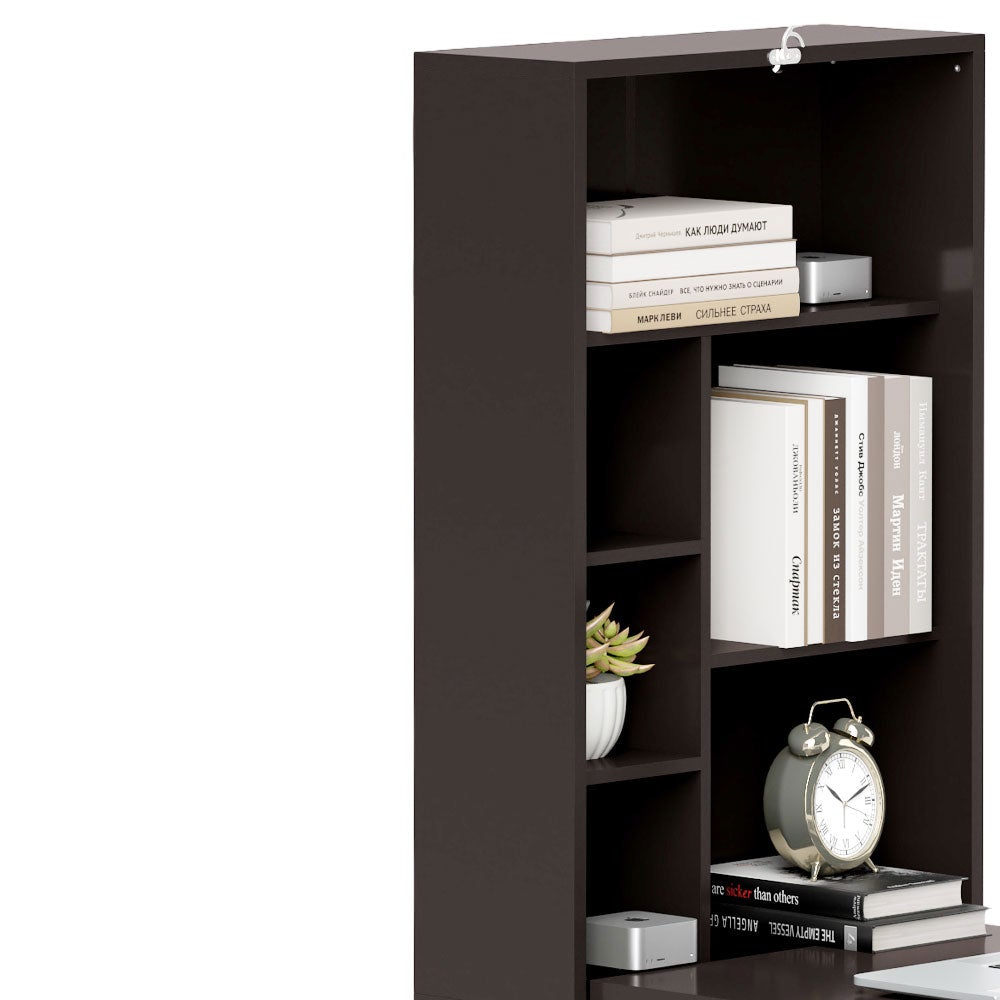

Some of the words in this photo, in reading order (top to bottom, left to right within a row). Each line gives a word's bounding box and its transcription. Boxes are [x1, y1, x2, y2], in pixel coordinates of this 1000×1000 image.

[685, 225, 702, 238] КАК
[703, 223, 729, 236] ЛЮДИ
[730, 220, 768, 235] ДУМАЮТ
[629, 290, 647, 299] БЛЕЙК
[648, 288, 674, 298] СНАЙДЕР
[693, 286, 704, 294] ЧТО
[705, 284, 728, 293] НУЖНО
[728, 282, 746, 291] ЗНАТЬ
[637, 313, 659, 324] МАРК
[659, 312, 682, 322] ЛЕВИ
[695, 306, 737, 320] СИЛЬНЕЕ
[740, 303, 772, 317] СТРАХА
[792, 444, 800, 514] ДЖОВАНЬОЛИ
[857, 461, 865, 497] Джобс
[918, 470, 928, 500] Кант
[891, 494, 905, 552] Мартин
[833, 554, 841, 569] из
[916, 522, 927, 603] ТРАКТАТЫ
[789, 555, 802, 616] Спартак
[891, 558, 905, 597] Иден
[832, 574, 841, 620] стекла
[711, 884, 725, 895] are
[726, 882, 752, 899] sicker
[753, 887, 772, 902] than
[773, 892, 799, 907] others
[721, 916, 759, 933] ANGELLA
[768, 921, 797, 938] VESSEL
[796, 924, 821, 941] EMPTY
[821, 928, 836, 944] THE
